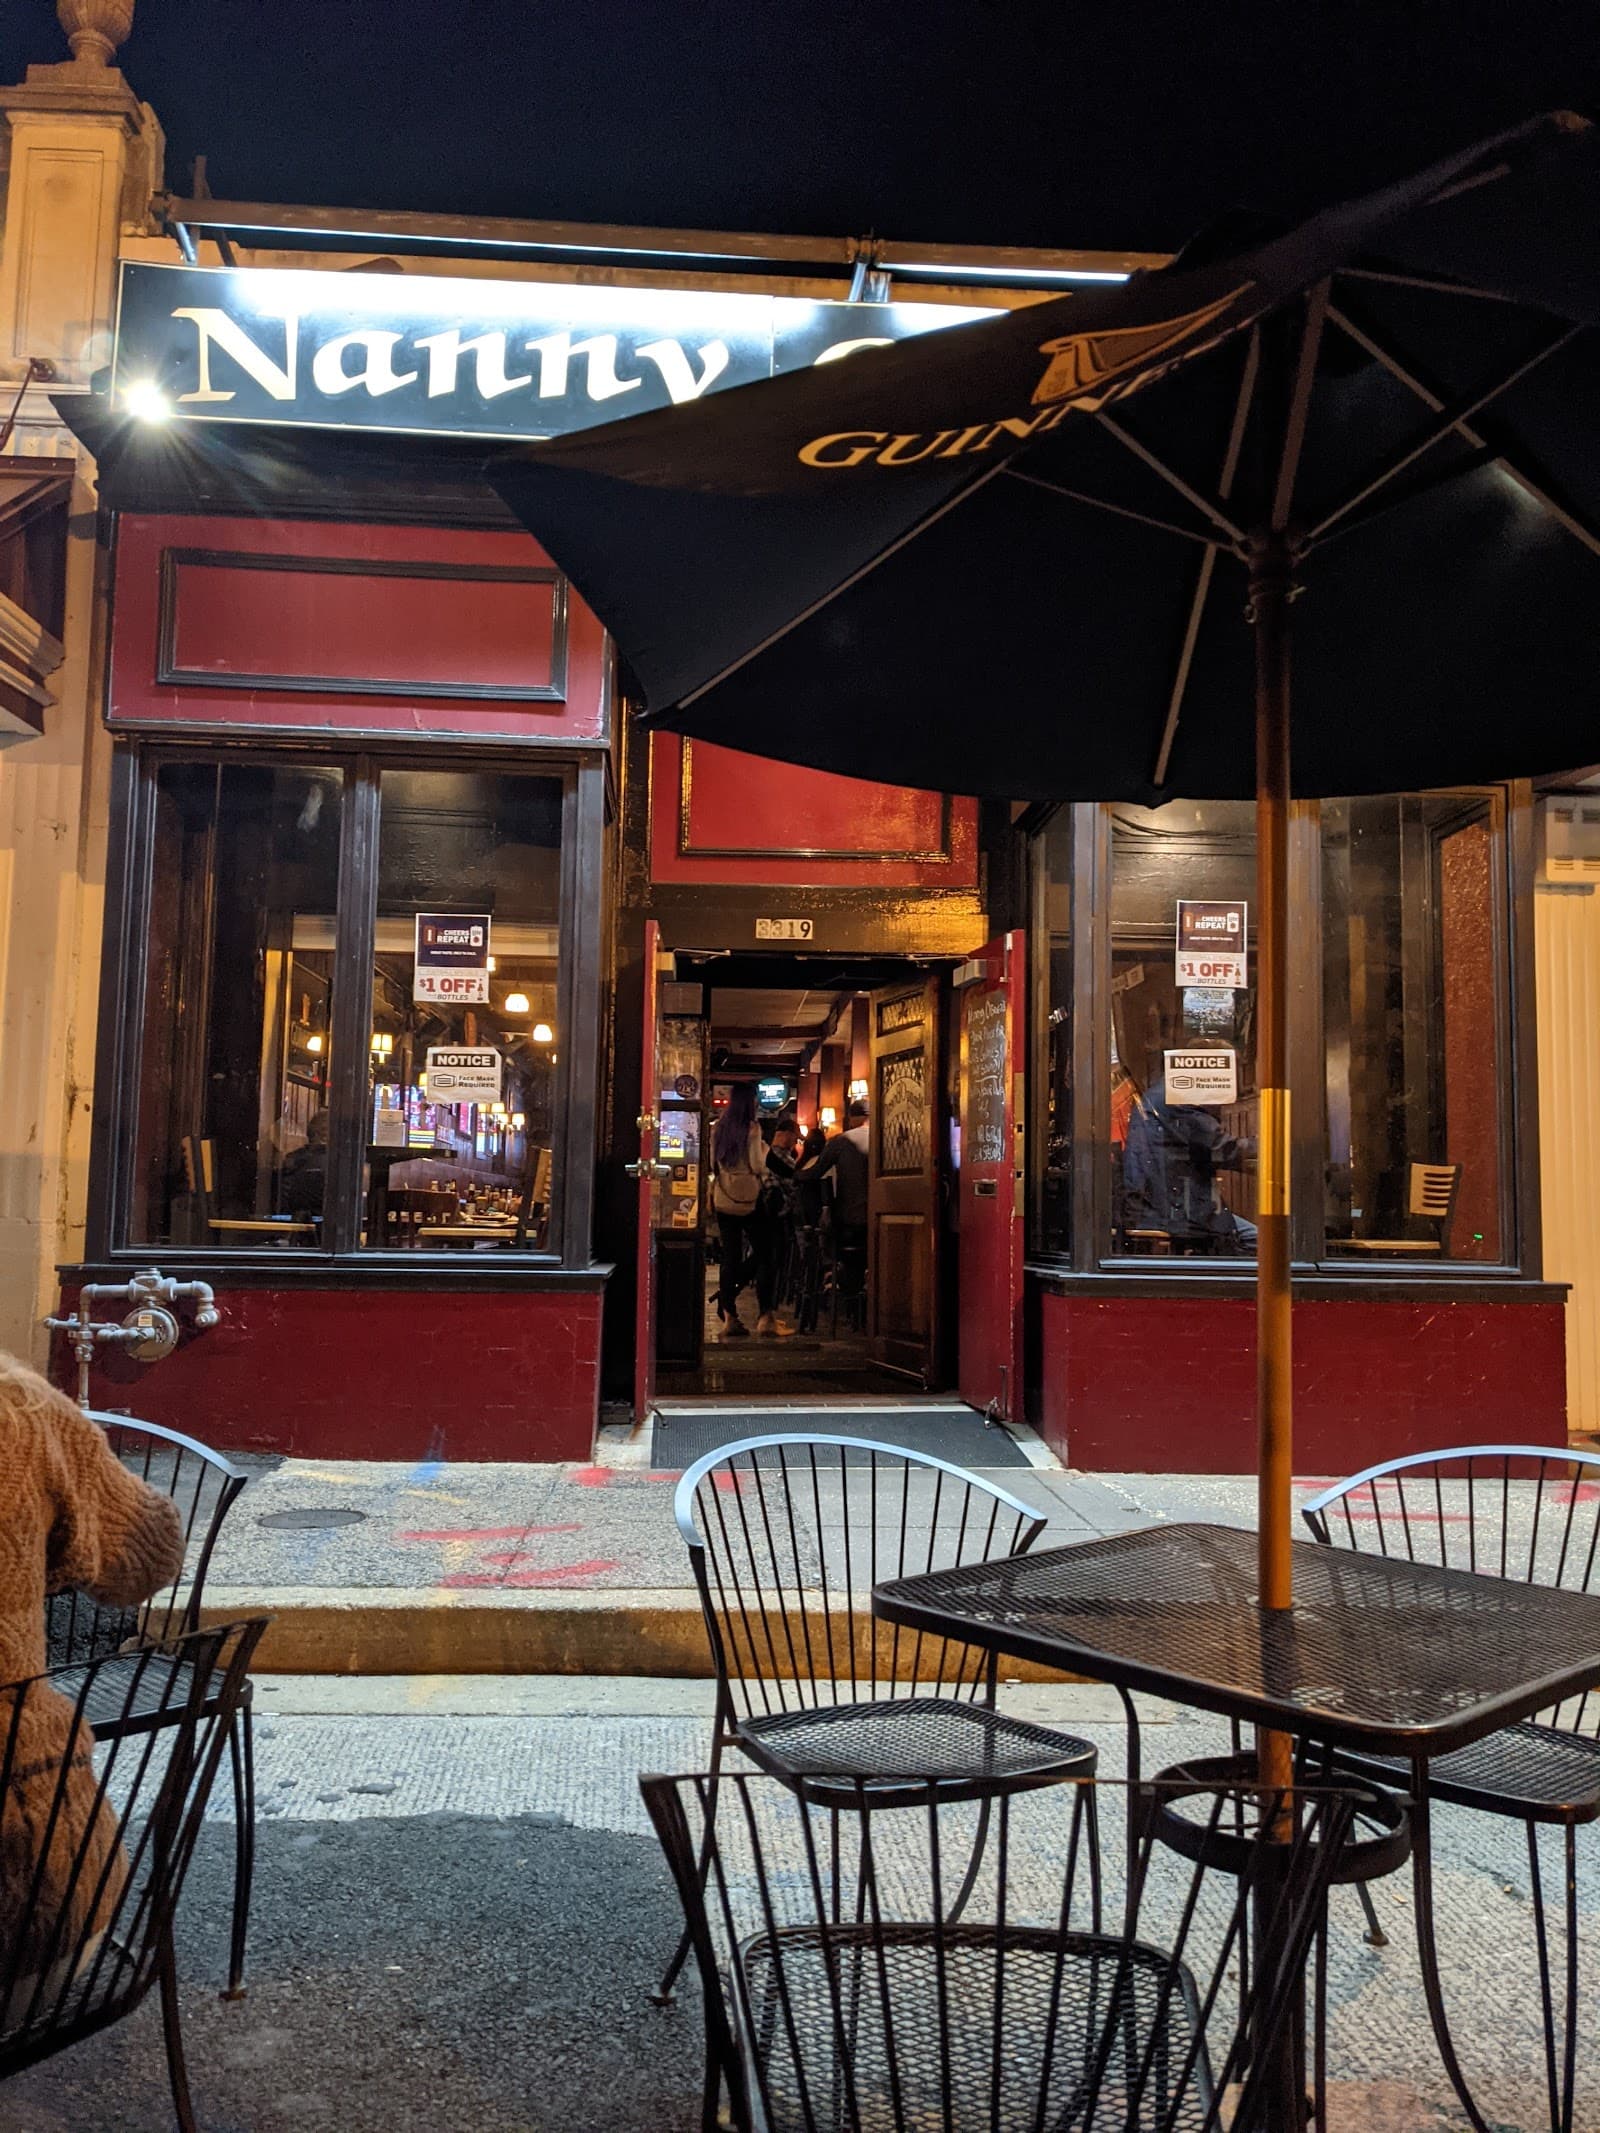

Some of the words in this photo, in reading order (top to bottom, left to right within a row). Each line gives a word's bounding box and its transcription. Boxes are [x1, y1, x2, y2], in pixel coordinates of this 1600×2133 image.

[171, 306, 728, 404] Nanny
[758, 920, 811, 938] 3319
[1194, 921, 1227, 929] REPEAT
[436, 935, 470, 943] REPEAT
[1180, 962, 1196, 977] $1
[1199, 962, 1234, 977] OFF
[419, 977, 436, 993] $1
[440, 978, 477, 993] OFF
[437, 1055, 491, 1066] NOTICE
[1174, 1057, 1226, 1068] NOTICE
